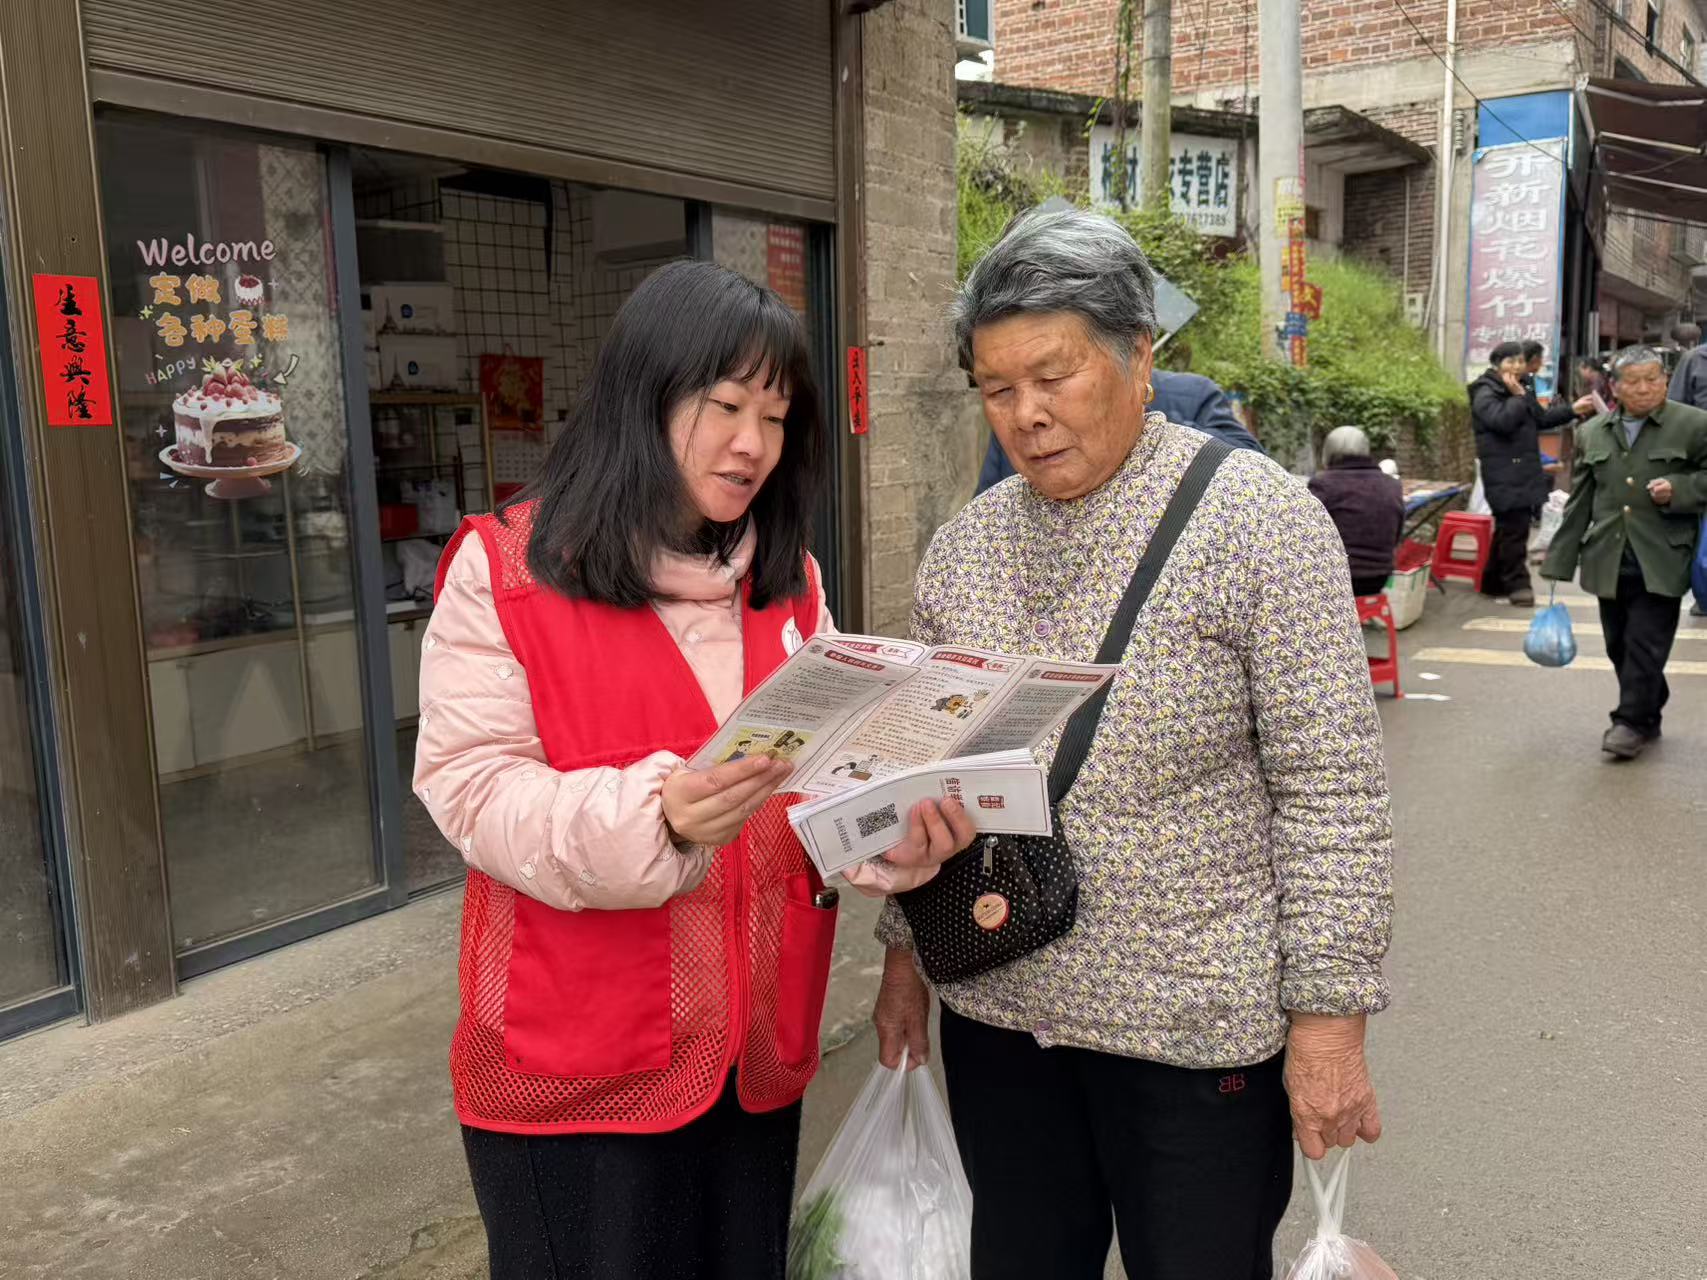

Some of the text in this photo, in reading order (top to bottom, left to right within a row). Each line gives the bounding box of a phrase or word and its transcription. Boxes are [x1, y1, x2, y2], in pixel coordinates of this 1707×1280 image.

[137, 233, 276, 266] Welcome
[149, 271, 221, 305] 定做
[156, 309, 289, 347] 各种蛋糕
